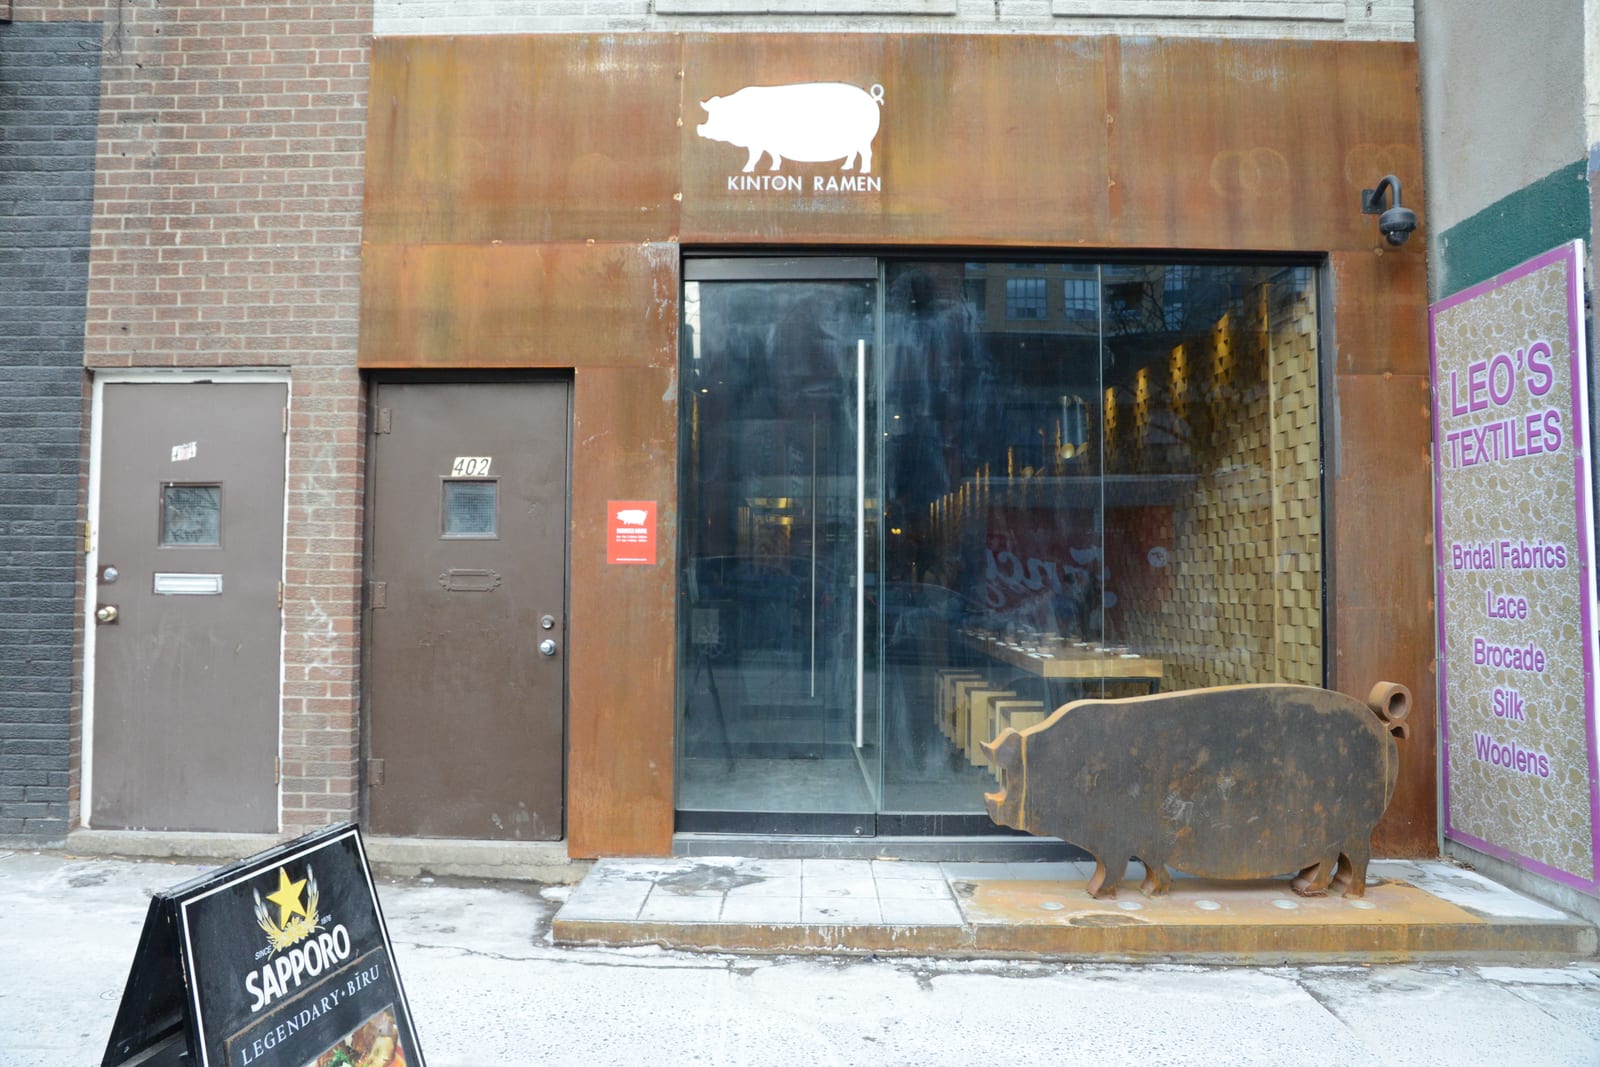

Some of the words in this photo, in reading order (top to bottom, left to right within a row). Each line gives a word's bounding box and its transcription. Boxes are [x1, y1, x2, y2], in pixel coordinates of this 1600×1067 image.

[727, 175, 802, 191] KINTON
[813, 176, 882, 192] RAMEN
[1450, 342, 1553, 417] LEO'S
[1447, 410, 1561, 468] TEXTILES
[453, 458, 490, 476] 402
[1452, 543, 1496, 570] Bridal
[1500, 540, 1567, 569] Fabrics
[1487, 590, 1528, 619] Lace
[1473, 638, 1546, 673] Brocade
[1493, 688, 1524, 721] Silk
[1474, 733, 1550, 778] Woolens
[245, 924, 351, 1013] SAPPORO
[254, 945, 272, 961] SINCE
[241, 989, 338, 1066] LEGENDARY
